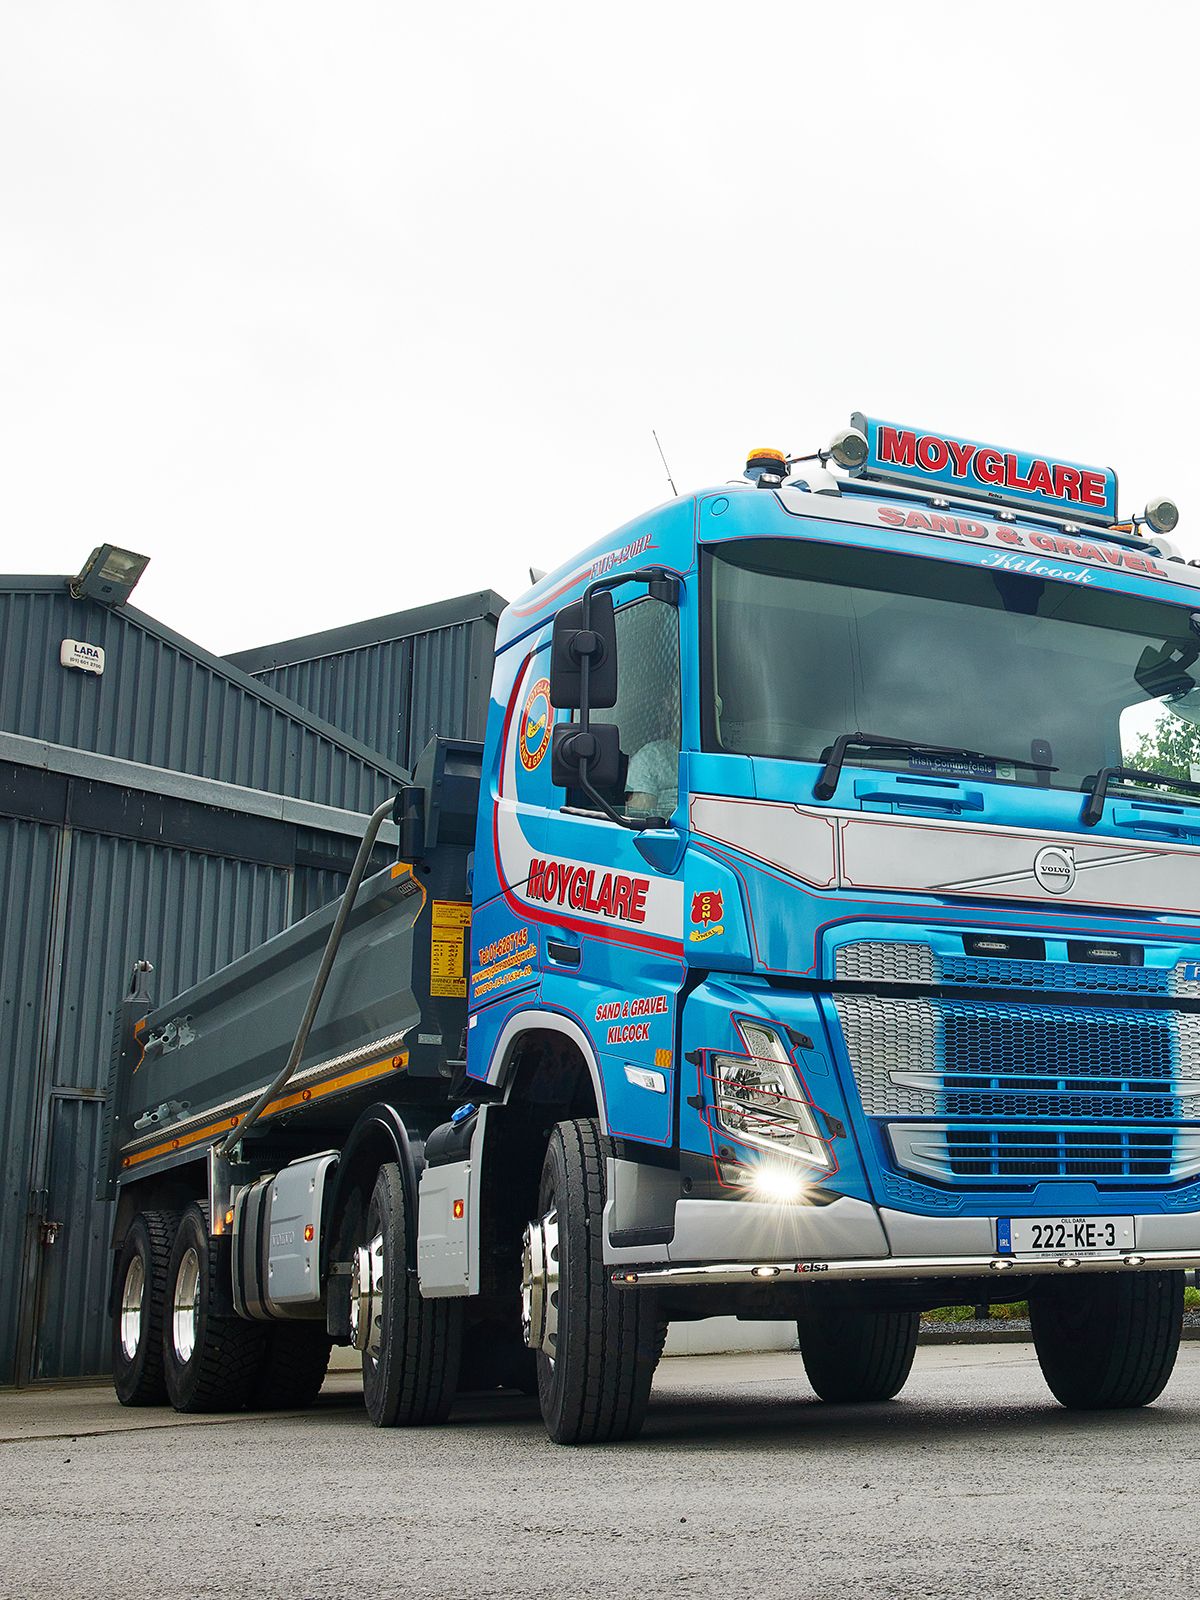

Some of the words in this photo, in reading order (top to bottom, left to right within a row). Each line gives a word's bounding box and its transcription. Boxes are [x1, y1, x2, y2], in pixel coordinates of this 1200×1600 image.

[876, 426, 1107, 507] MOYGLARE
[878, 507, 989, 539] SAND
[994, 526, 1025, 547] &
[1029, 531, 1169, 578] GRAVEL
[980, 552, 1097, 585] Kilcock
[74, 645, 99, 658] LARA
[911, 756, 931, 767] Irish
[934, 759, 993, 774] Commercials
[1040, 866, 1071, 874] VOLVO
[526, 858, 650, 924] MOYGLARE
[702, 896, 711, 919] CON
[595, 1001, 621, 1022] SAND
[622, 1000, 629, 1018] &
[630, 995, 669, 1017] GRAVEL
[606, 1022, 651, 1045] KILCOCK
[999, 1238, 1010, 1247] IRL
[1031, 1223, 1116, 1249] 222-KE-3
[793, 1262, 829, 1273] Kelsa
